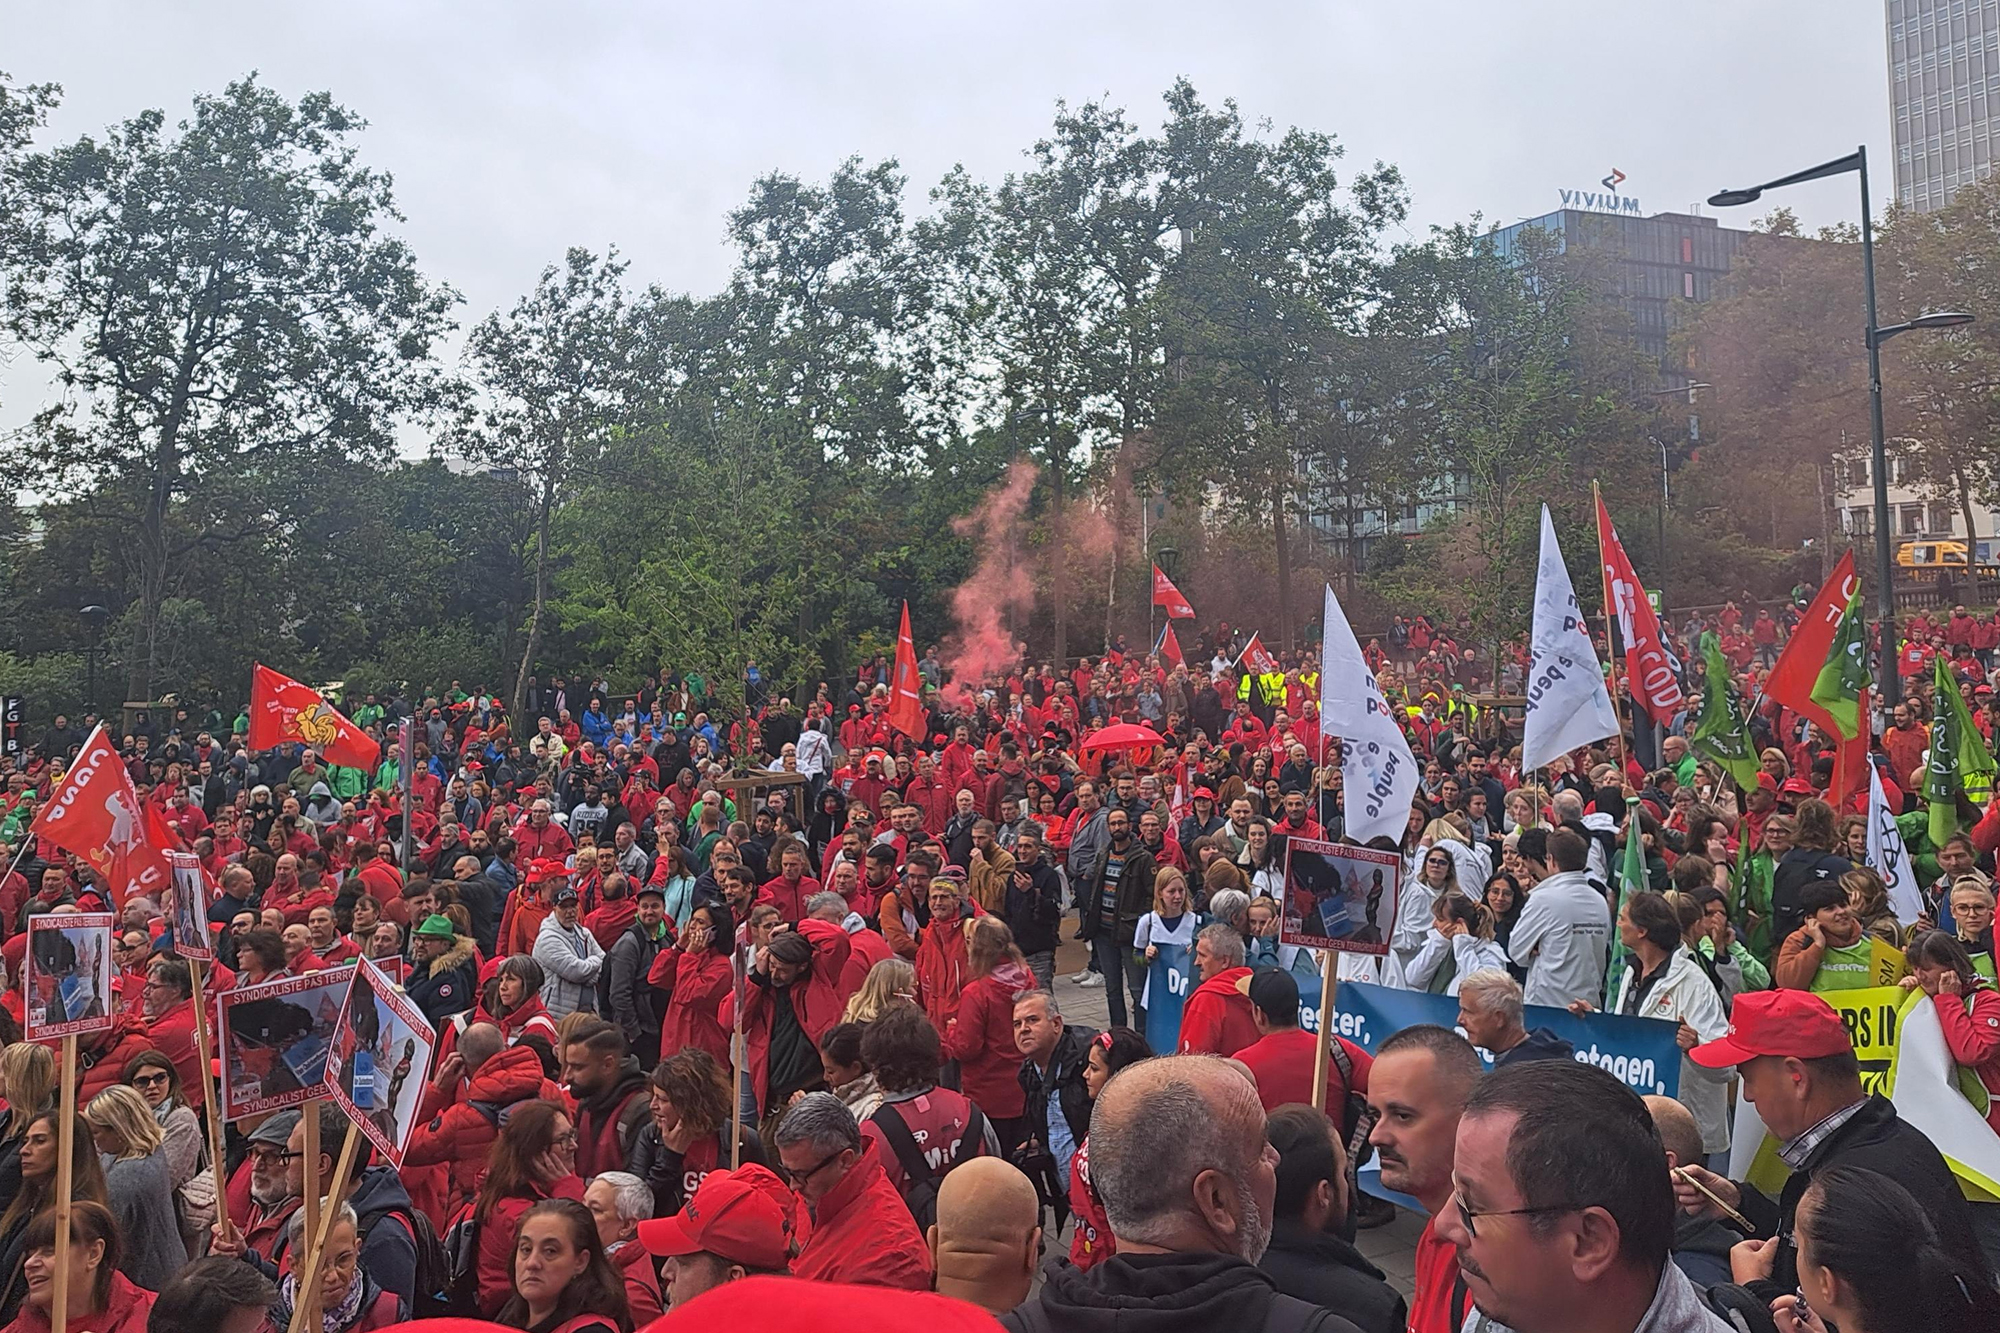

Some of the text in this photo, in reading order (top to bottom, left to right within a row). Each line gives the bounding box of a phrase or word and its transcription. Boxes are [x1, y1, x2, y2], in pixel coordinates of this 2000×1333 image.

[1558, 188, 1640, 212] VIVIUM
[5, 699, 20, 751] FGTB
[46, 748, 110, 822] CGSP
[1295, 841, 1339, 856] SYNDICALISTE
[1340, 847, 1353, 858] PAS
[1328, 938, 1345, 949] GEEN
[233, 981, 302, 1004] SYNDICALISTE
[304, 976, 323, 990] PAS
[385, 990, 397, 1008] PAS
[242, 1088, 305, 1114] SYNDICALIST
